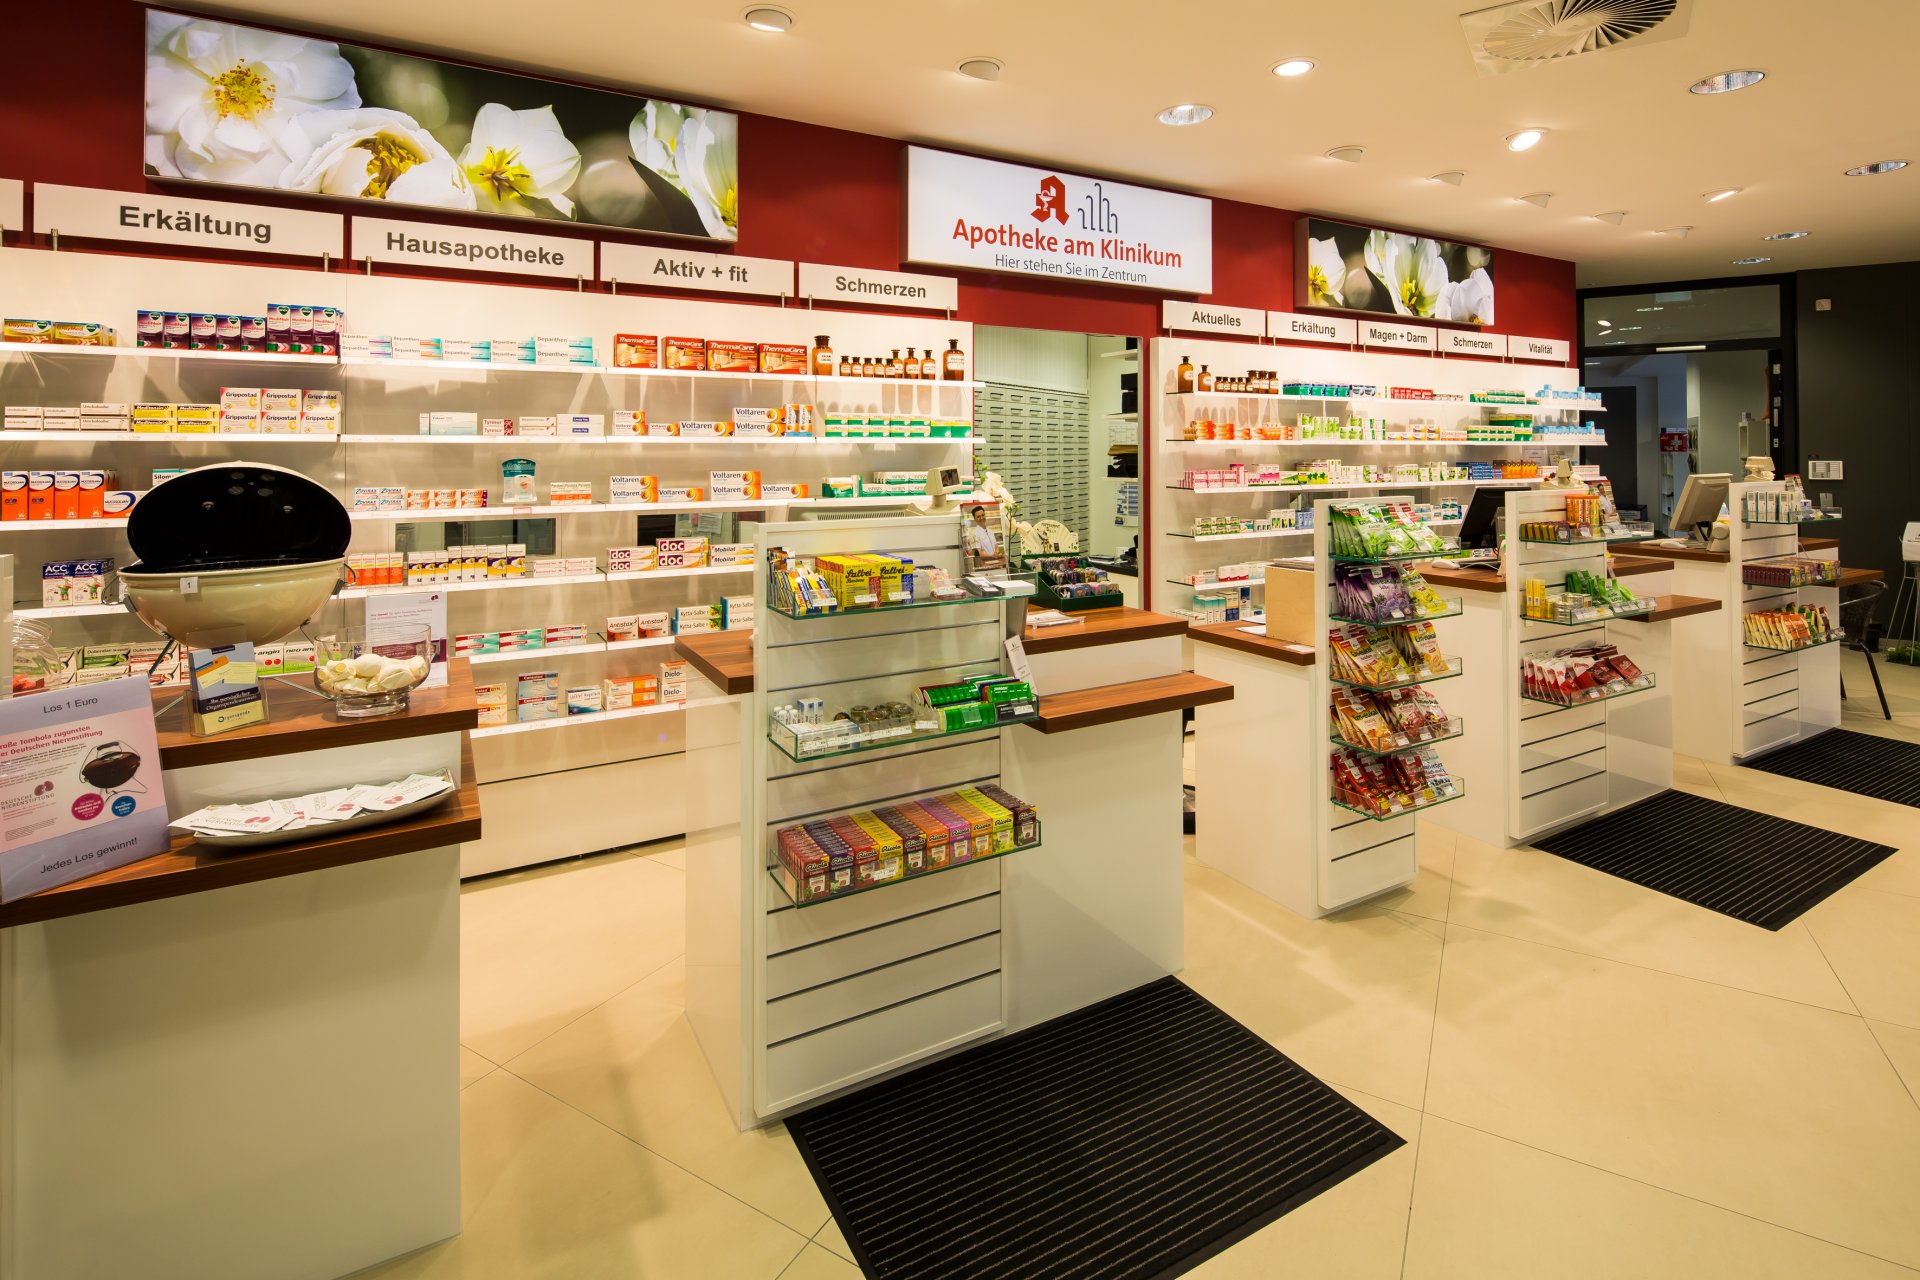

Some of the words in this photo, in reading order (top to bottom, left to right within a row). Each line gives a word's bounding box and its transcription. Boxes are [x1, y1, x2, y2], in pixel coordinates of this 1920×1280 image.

[120, 205, 272, 244] Erkältung
[952, 219, 1058, 252] Apotheke
[1064, 237, 1094, 257] am
[1101, 239, 1182, 268] Klinikum
[387, 232, 564, 266] Hausapotheke
[653, 259, 704, 278] Aktiv
[712, 266, 722, 278] +
[729, 266, 748, 282] fit
[996, 254, 1020, 269] Hier
[1024, 258, 1062, 274] stehen
[1066, 262, 1082, 276] Sie
[1085, 265, 1098, 278] im
[1102, 266, 1147, 283] Zentrum
[836, 276, 926, 298] Schmerzen
[1192, 310, 1241, 327] Aktuelles
[1291, 321, 1336, 338] Erkältung
[619, 336, 655, 344] ThermaCare
[1370, 328, 1398, 342] Magen
[1406, 332, 1428, 344] Darm
[710, 342, 754, 350] ThermaCare
[1454, 337, 1492, 350] Schmerzen
[763, 345, 804, 353] ThermaCare
[1528, 344, 1552, 354] Vitalität
[681, 422, 712, 430] Voltaren
[660, 541, 684, 551] doc
[611, 551, 630, 559] doc
[611, 562, 630, 570] doc
[659, 556, 683, 566] doc
[45, 565, 67, 573] ACC
[74, 564, 97, 572] ACC
[845, 568, 875, 578] Salbei-
[609, 622, 634, 630] Antistax
[640, 618, 664, 626] Antistax
[43, 704, 62, 713] Los
[75, 697, 98, 707] Euro
[0, 741, 17, 750] roße
[19, 734, 51, 745] Tombola
[54, 726, 91, 739] zugunsten
[10, 742, 50, 755] Deutschen
[52, 729, 103, 746] Nierenstiftung
[0, 793, 33, 806] DEUTSCHE
[1, 792, 55, 810] NIERENSTIFTUNG
[1018, 812, 1035, 820] Ricola
[973, 822, 991, 830] Ricola
[994, 818, 1012, 827] Ricola
[951, 827, 970, 837] Ricola
[929, 833, 948, 842] Ricola
[905, 838, 926, 848] Ricola
[882, 844, 902, 853] Ricola
[40, 858, 72, 874] Jedes
[75, 852, 94, 863] Los
[96, 837, 138, 857] gewinnt!
[856, 850, 878, 860] Ricola
[831, 856, 854, 866] Ricola
[806, 862, 828, 872] Ricola
